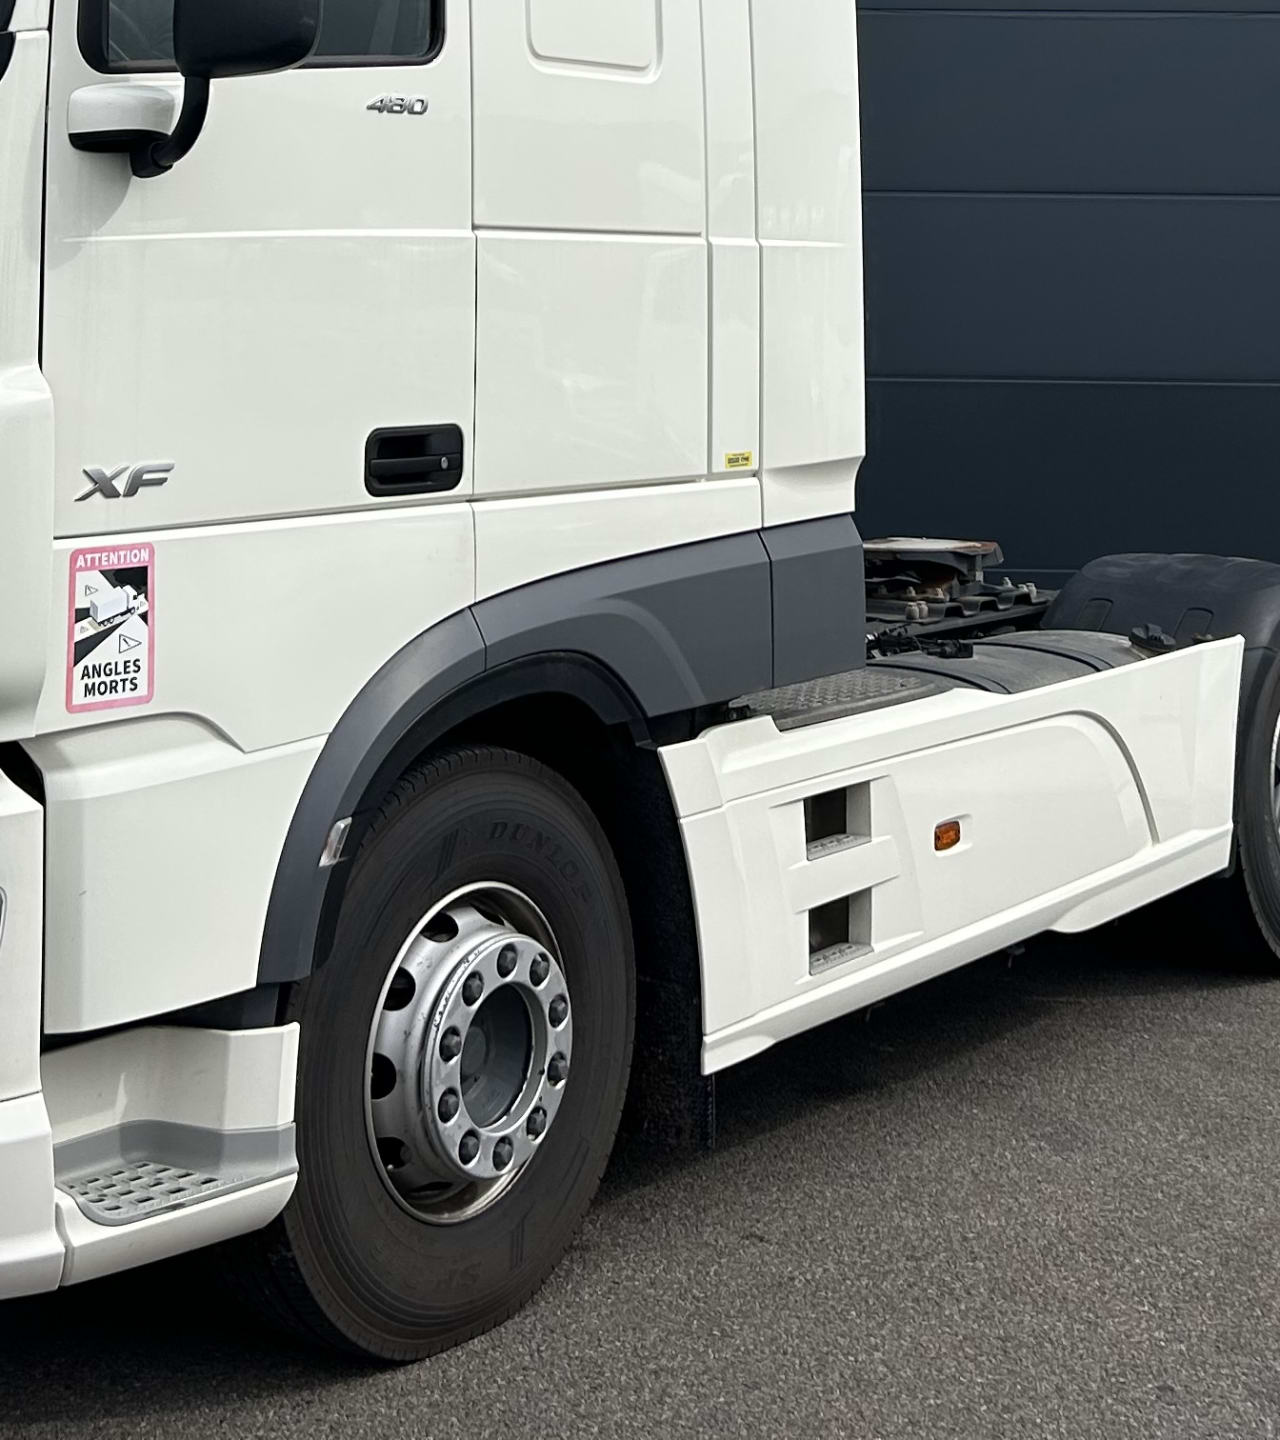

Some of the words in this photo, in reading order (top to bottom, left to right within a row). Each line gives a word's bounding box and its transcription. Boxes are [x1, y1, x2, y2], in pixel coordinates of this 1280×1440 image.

[366, 96, 429, 115] 480
[74, 463, 175, 502] XF
[76, 548, 150, 569] ATTENTION
[80, 658, 142, 680] ANGLES
[84, 676, 138, 698] MORTS
